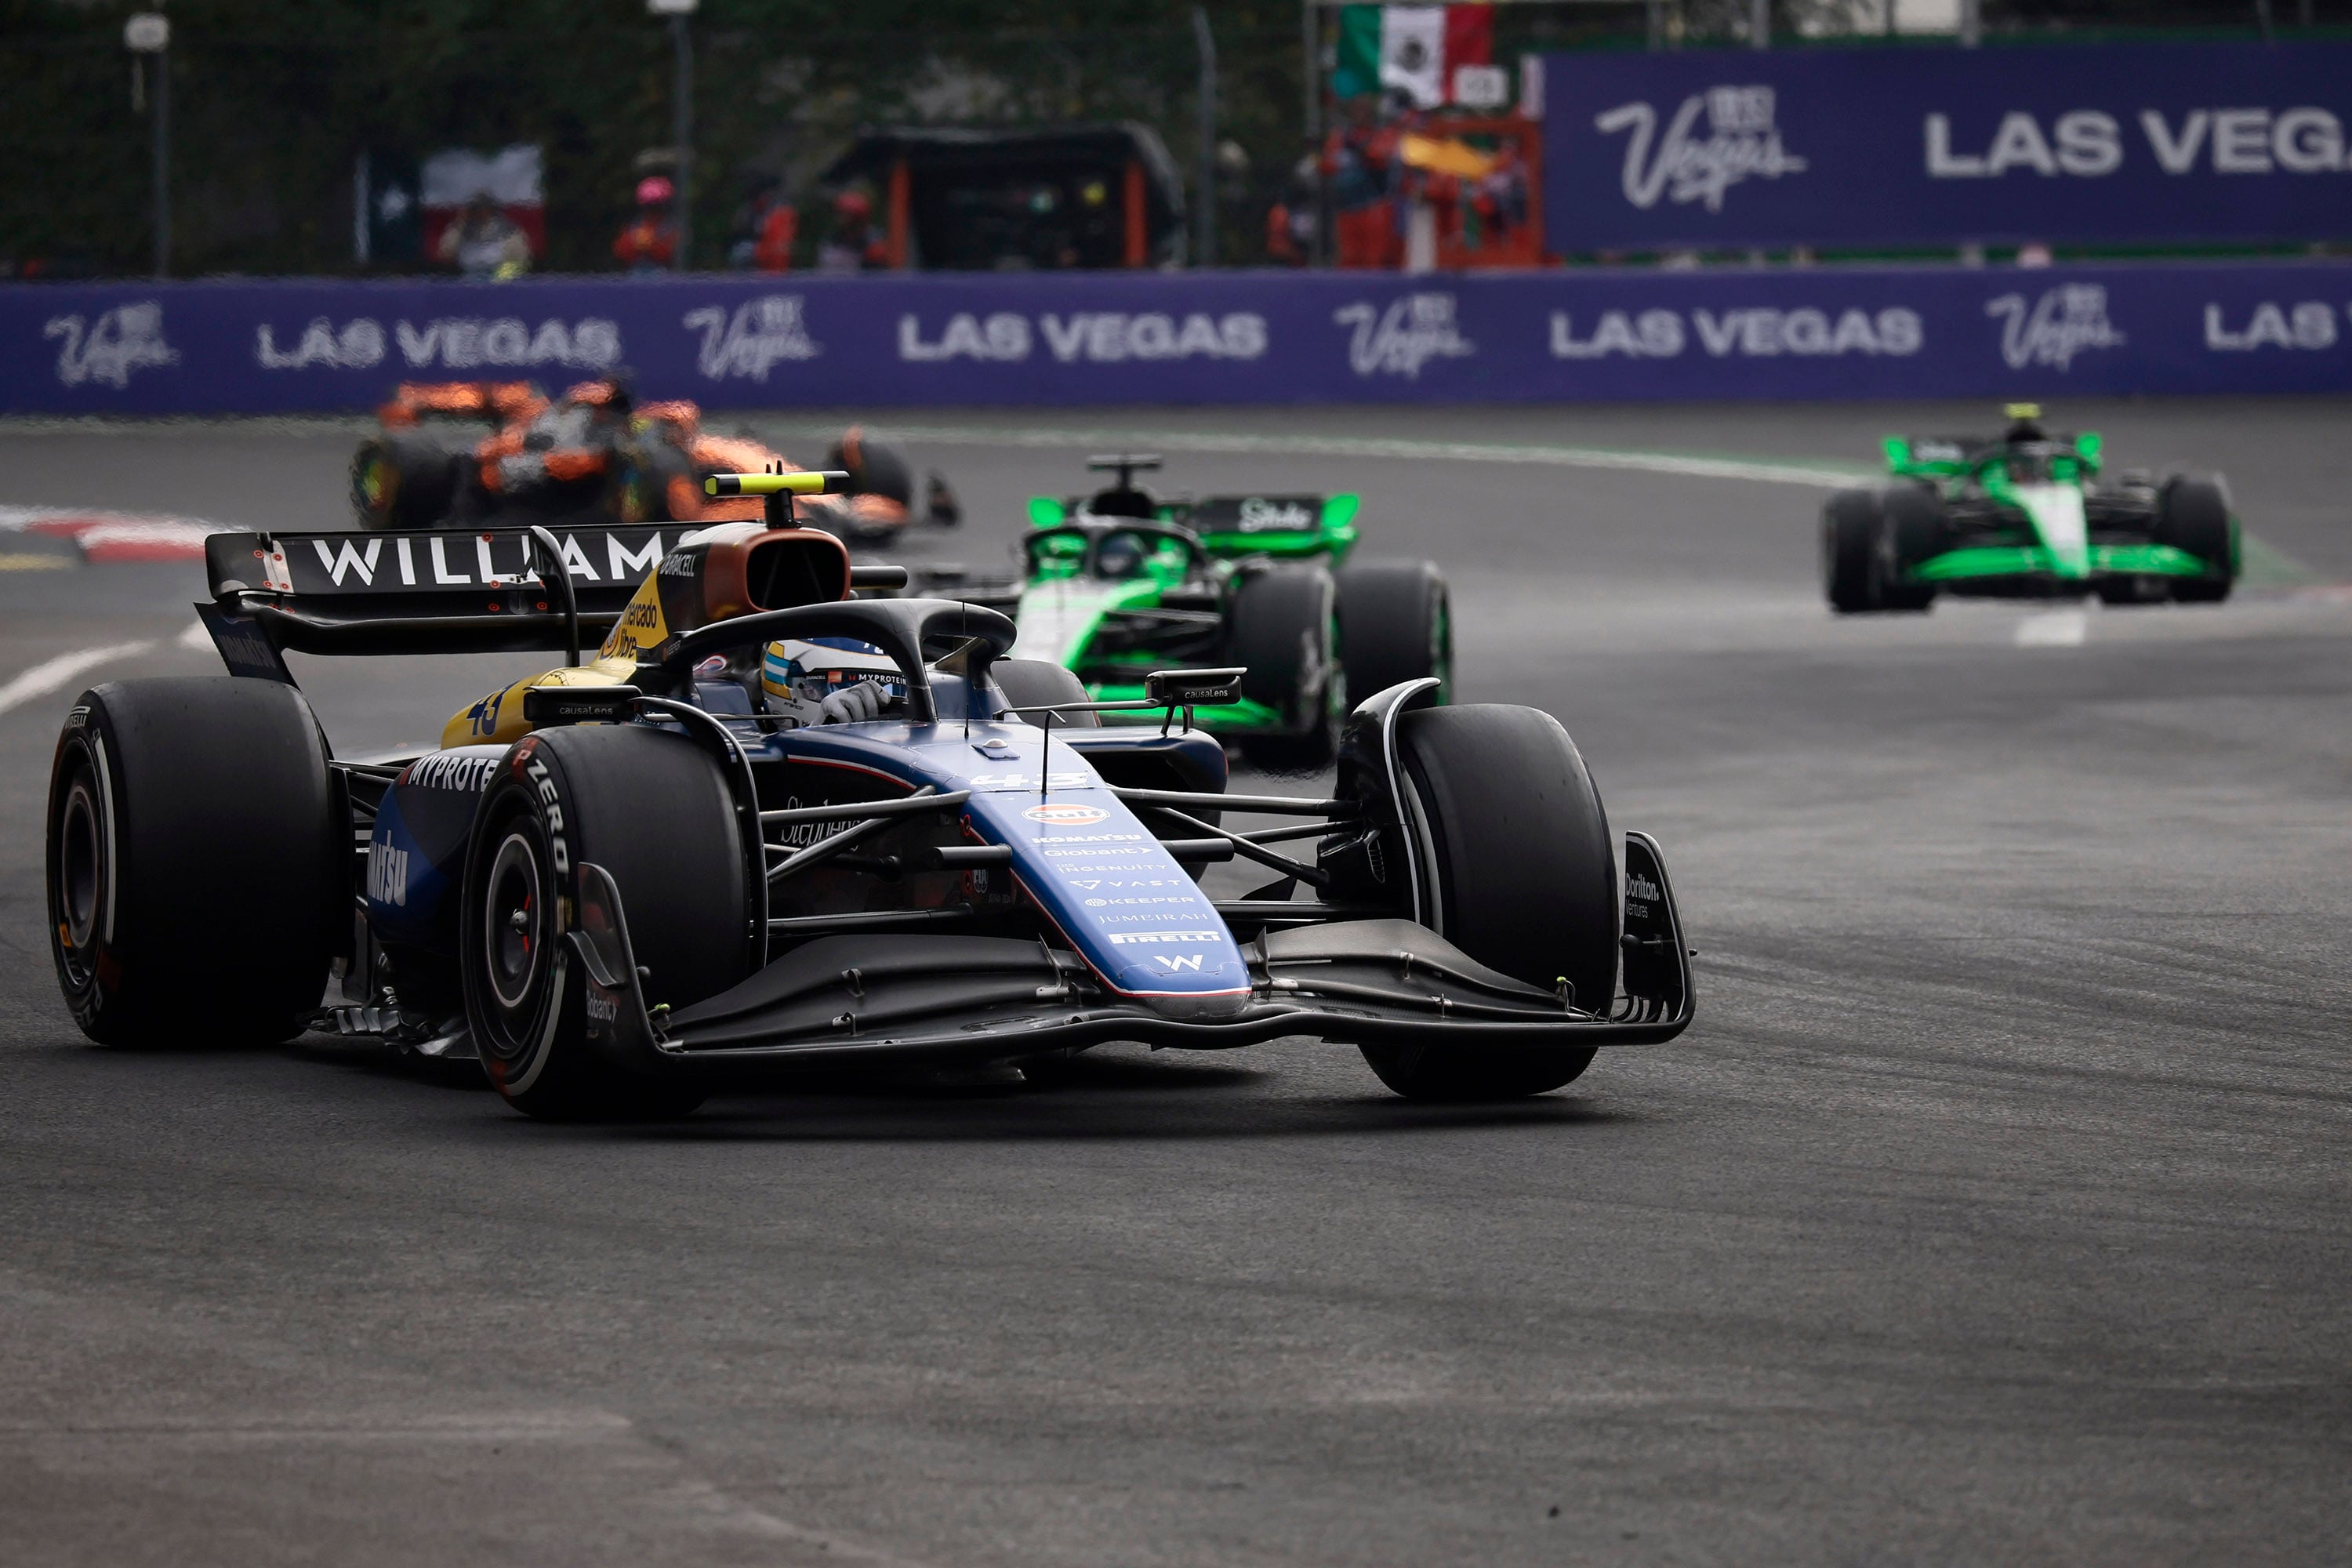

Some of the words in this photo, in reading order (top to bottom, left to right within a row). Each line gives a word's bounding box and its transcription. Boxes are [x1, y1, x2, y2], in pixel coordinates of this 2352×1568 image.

[1926, 110, 2124, 177] LAS
[2138, 107, 2352, 173] VEG
[898, 312, 1031, 361] LAS
[1040, 312, 1269, 361] VEGAS
[1550, 310, 1685, 358] LAS
[1693, 307, 1924, 356] VEGAS
[2204, 302, 2337, 350] LAS
[256, 316, 387, 368] LAS
[394, 316, 623, 368] VEGAS
[309, 529, 701, 586] WILLIAM
[659, 553, 696, 577] DURACELL
[858, 673, 908, 686] MYPROTEIN
[1184, 688, 1229, 699] causaLens
[466, 680, 521, 737] 43
[558, 706, 615, 716] causaLens
[407, 755, 500, 793] MYPROTE
[528, 757, 570, 875] ZERO
[1031, 833, 1142, 844] KOMATSU
[1044, 848, 1138, 857] Globant
[365, 829, 408, 907] MATSU
[1058, 863, 1167, 874] INGENUITY
[1109, 879, 1181, 887] VAST
[1108, 896, 1196, 906] KEEPER
[1625, 898, 1649, 919] Ventures
[1098, 913, 1208, 924] JUMEIRAH
[1108, 931, 1222, 945] PIRELLI
